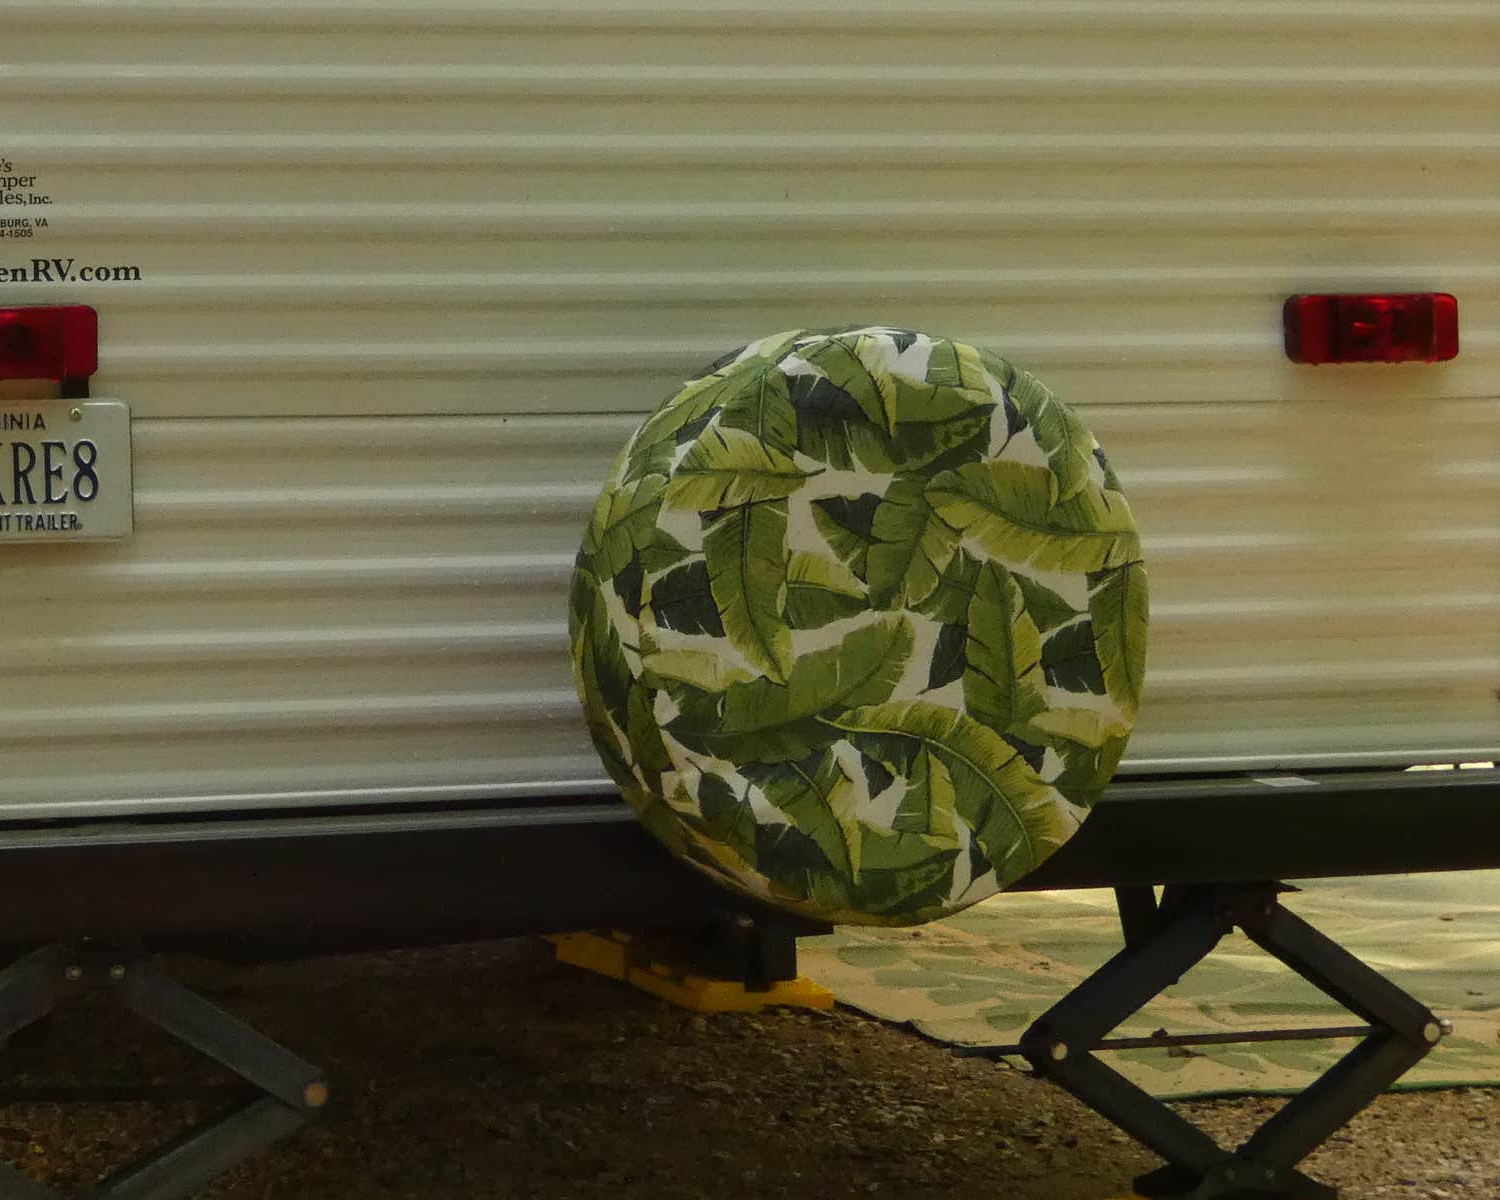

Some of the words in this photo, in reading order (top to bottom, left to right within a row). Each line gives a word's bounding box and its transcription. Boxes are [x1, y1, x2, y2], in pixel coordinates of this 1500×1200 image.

[28, 193, 53, 206] Inc.
[35, 217, 49, 228] VA
[15, 512, 79, 532] TRAILER
